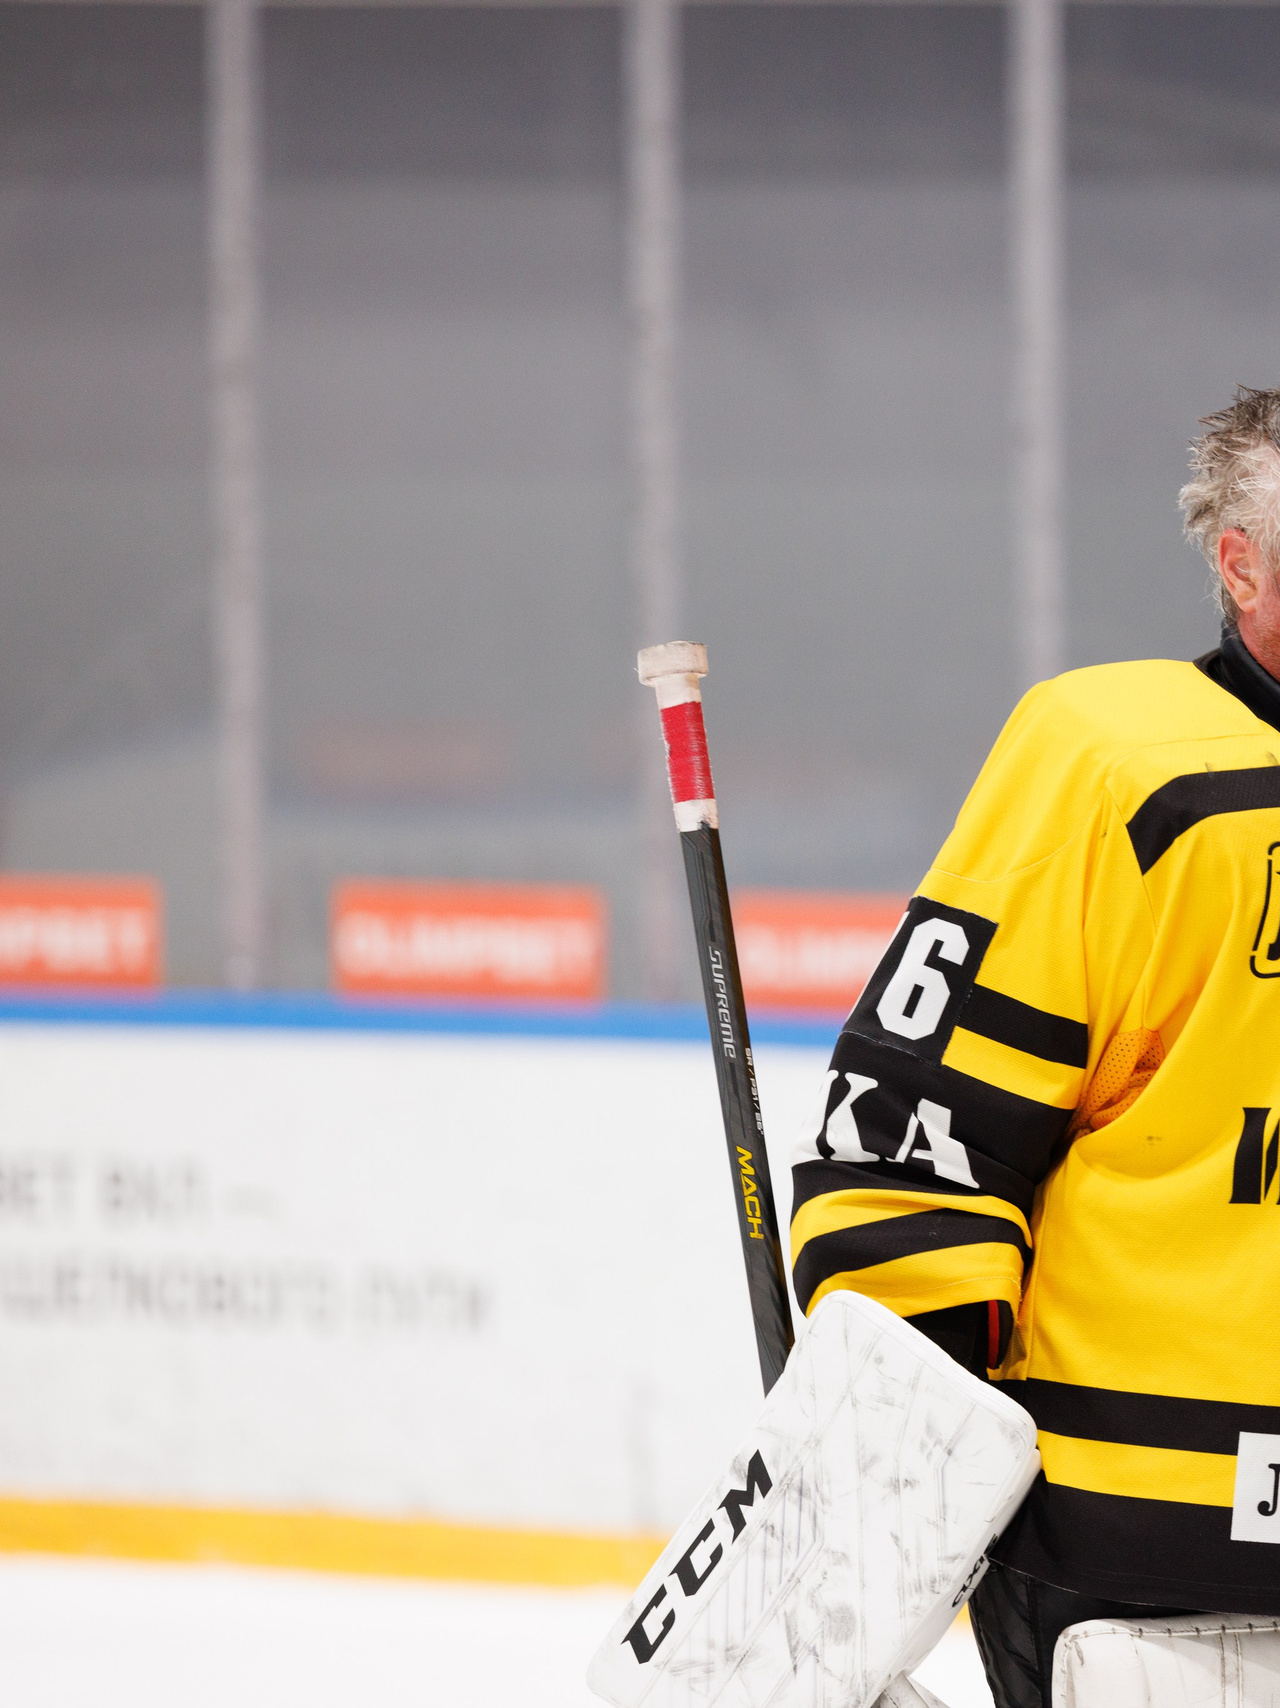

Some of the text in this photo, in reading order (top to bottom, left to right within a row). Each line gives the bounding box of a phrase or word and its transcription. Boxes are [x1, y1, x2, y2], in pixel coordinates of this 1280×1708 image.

[708, 945, 735, 1059] SUPREME
[735, 1145, 764, 1240] MACH
[620, 1449, 773, 1664] CCM
